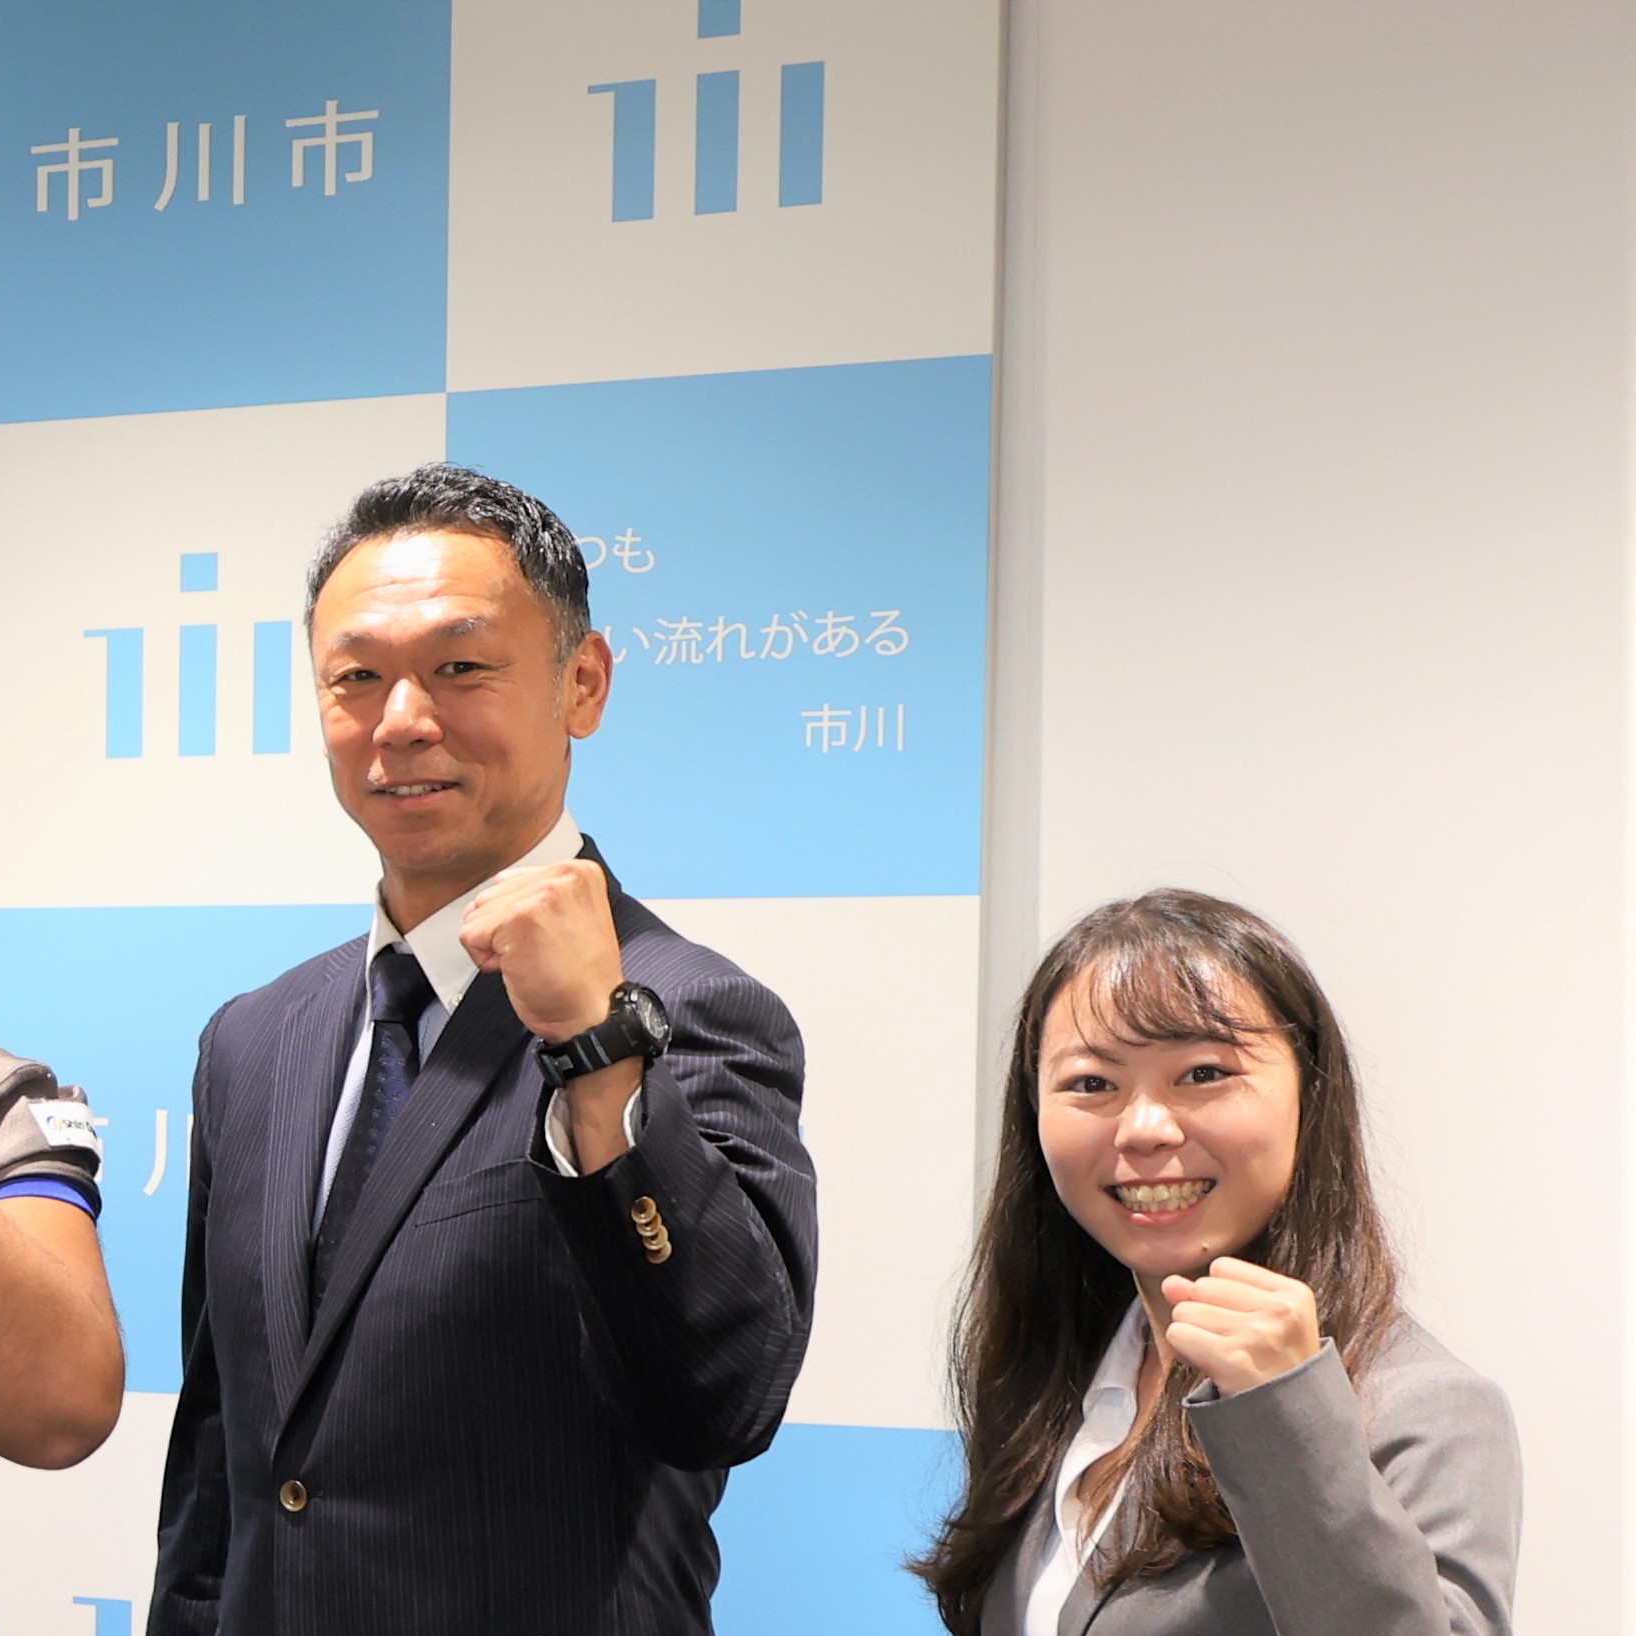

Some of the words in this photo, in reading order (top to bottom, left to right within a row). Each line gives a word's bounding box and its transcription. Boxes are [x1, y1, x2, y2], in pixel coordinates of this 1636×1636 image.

[30, 98, 380, 223] 市川市
[800, 703, 906, 754] 市川
